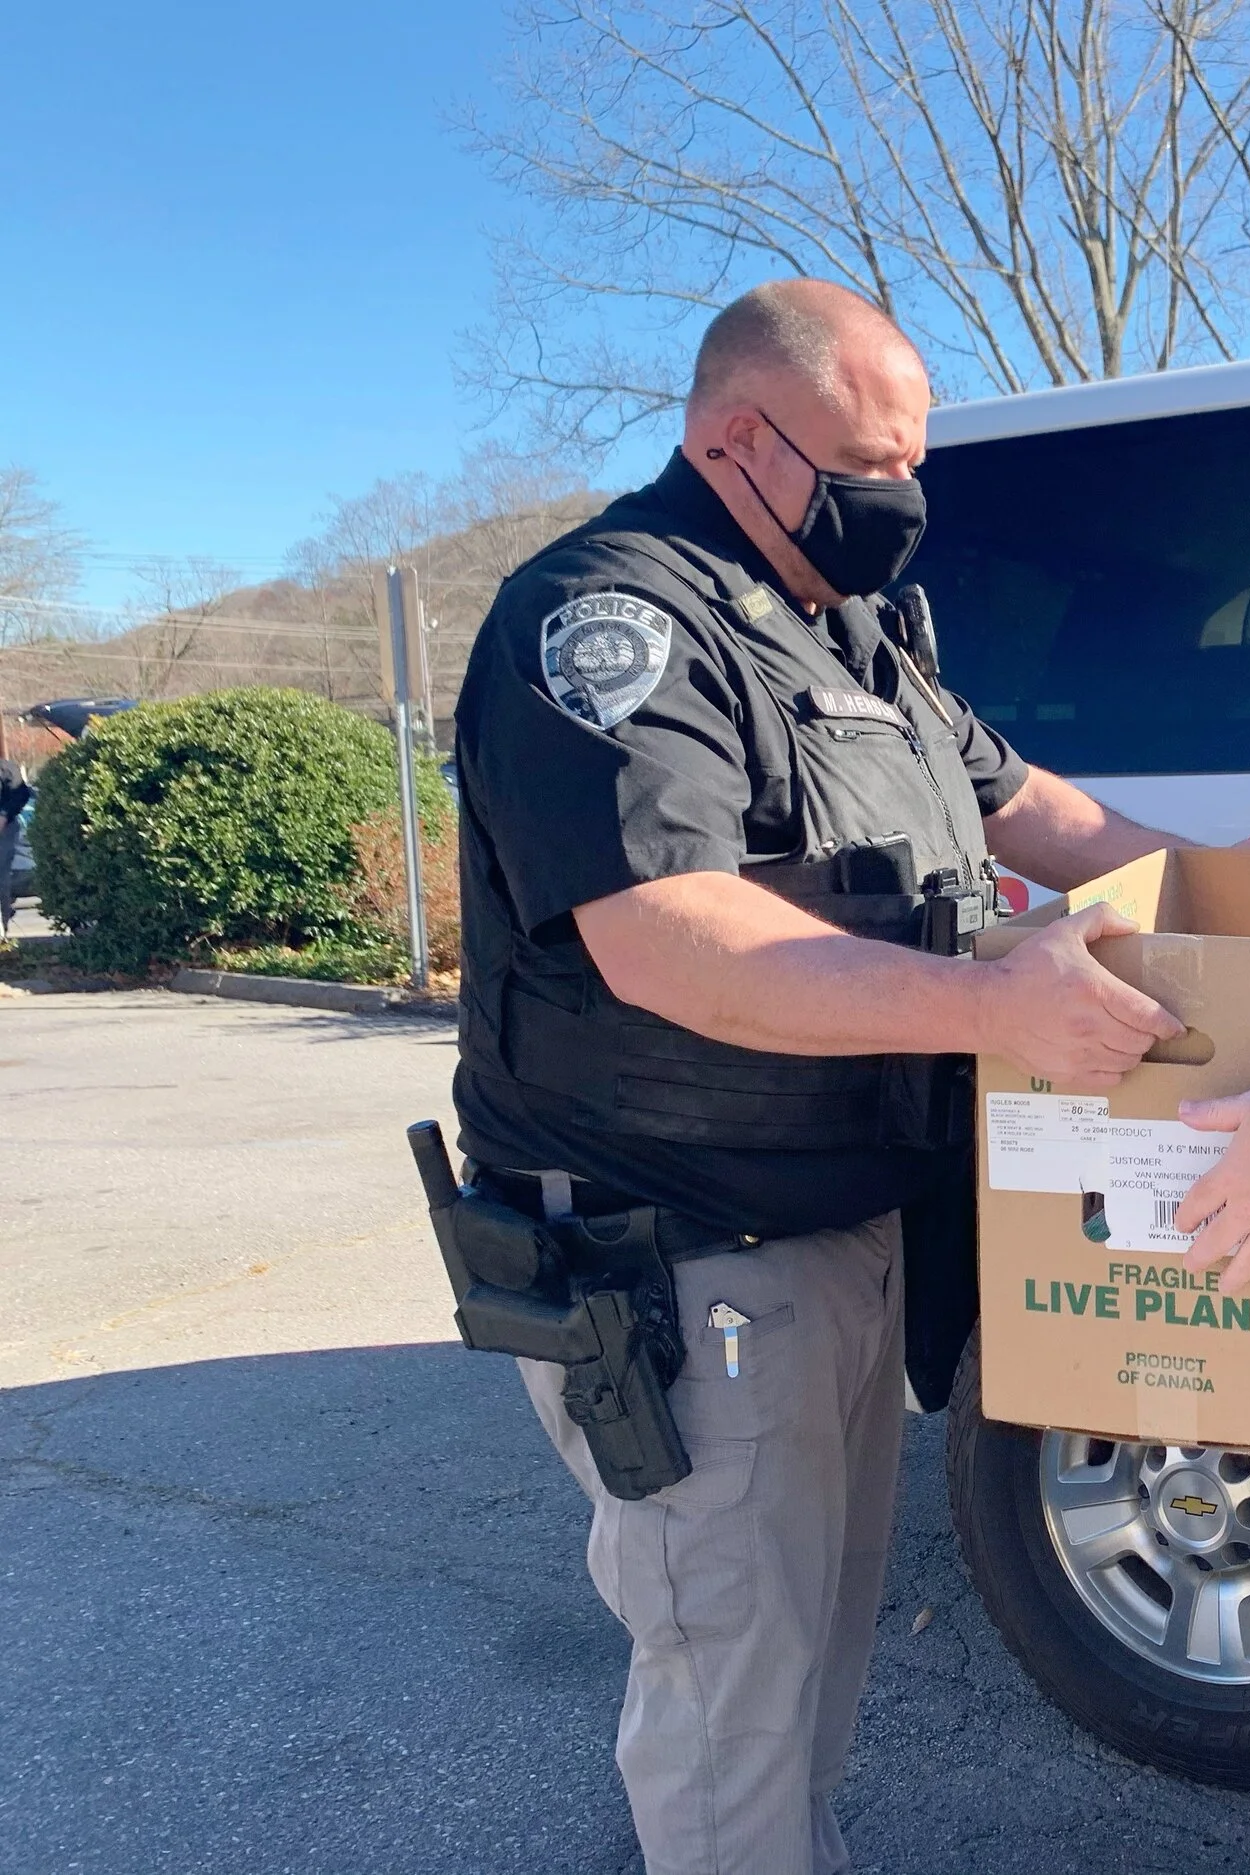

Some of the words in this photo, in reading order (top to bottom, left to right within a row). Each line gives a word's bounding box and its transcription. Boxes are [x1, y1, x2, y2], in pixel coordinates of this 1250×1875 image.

[559, 601, 656, 626] POLICE
[823, 692, 843, 712] M.
[1071, 1106, 1083, 1115] 80
[1098, 1107, 1109, 1116] 20
[1109, 1127, 1153, 1137] RODUCT
[1158, 1144, 1164, 1153] 8
[1166, 1144, 1174, 1153] X
[1188, 1145, 1211, 1155] MINI
[1109, 1156, 1162, 1166] CUSTOMER
[1135, 1171, 1152, 1179] VAN
[1109, 1263, 1221, 1292] FRAGILE
[1025, 1279, 1120, 1319] LIVE
[1125, 1352, 1207, 1373] PRODUCT
[1117, 1370, 1139, 1385] OF
[1144, 1373, 1215, 1393] CANADA
